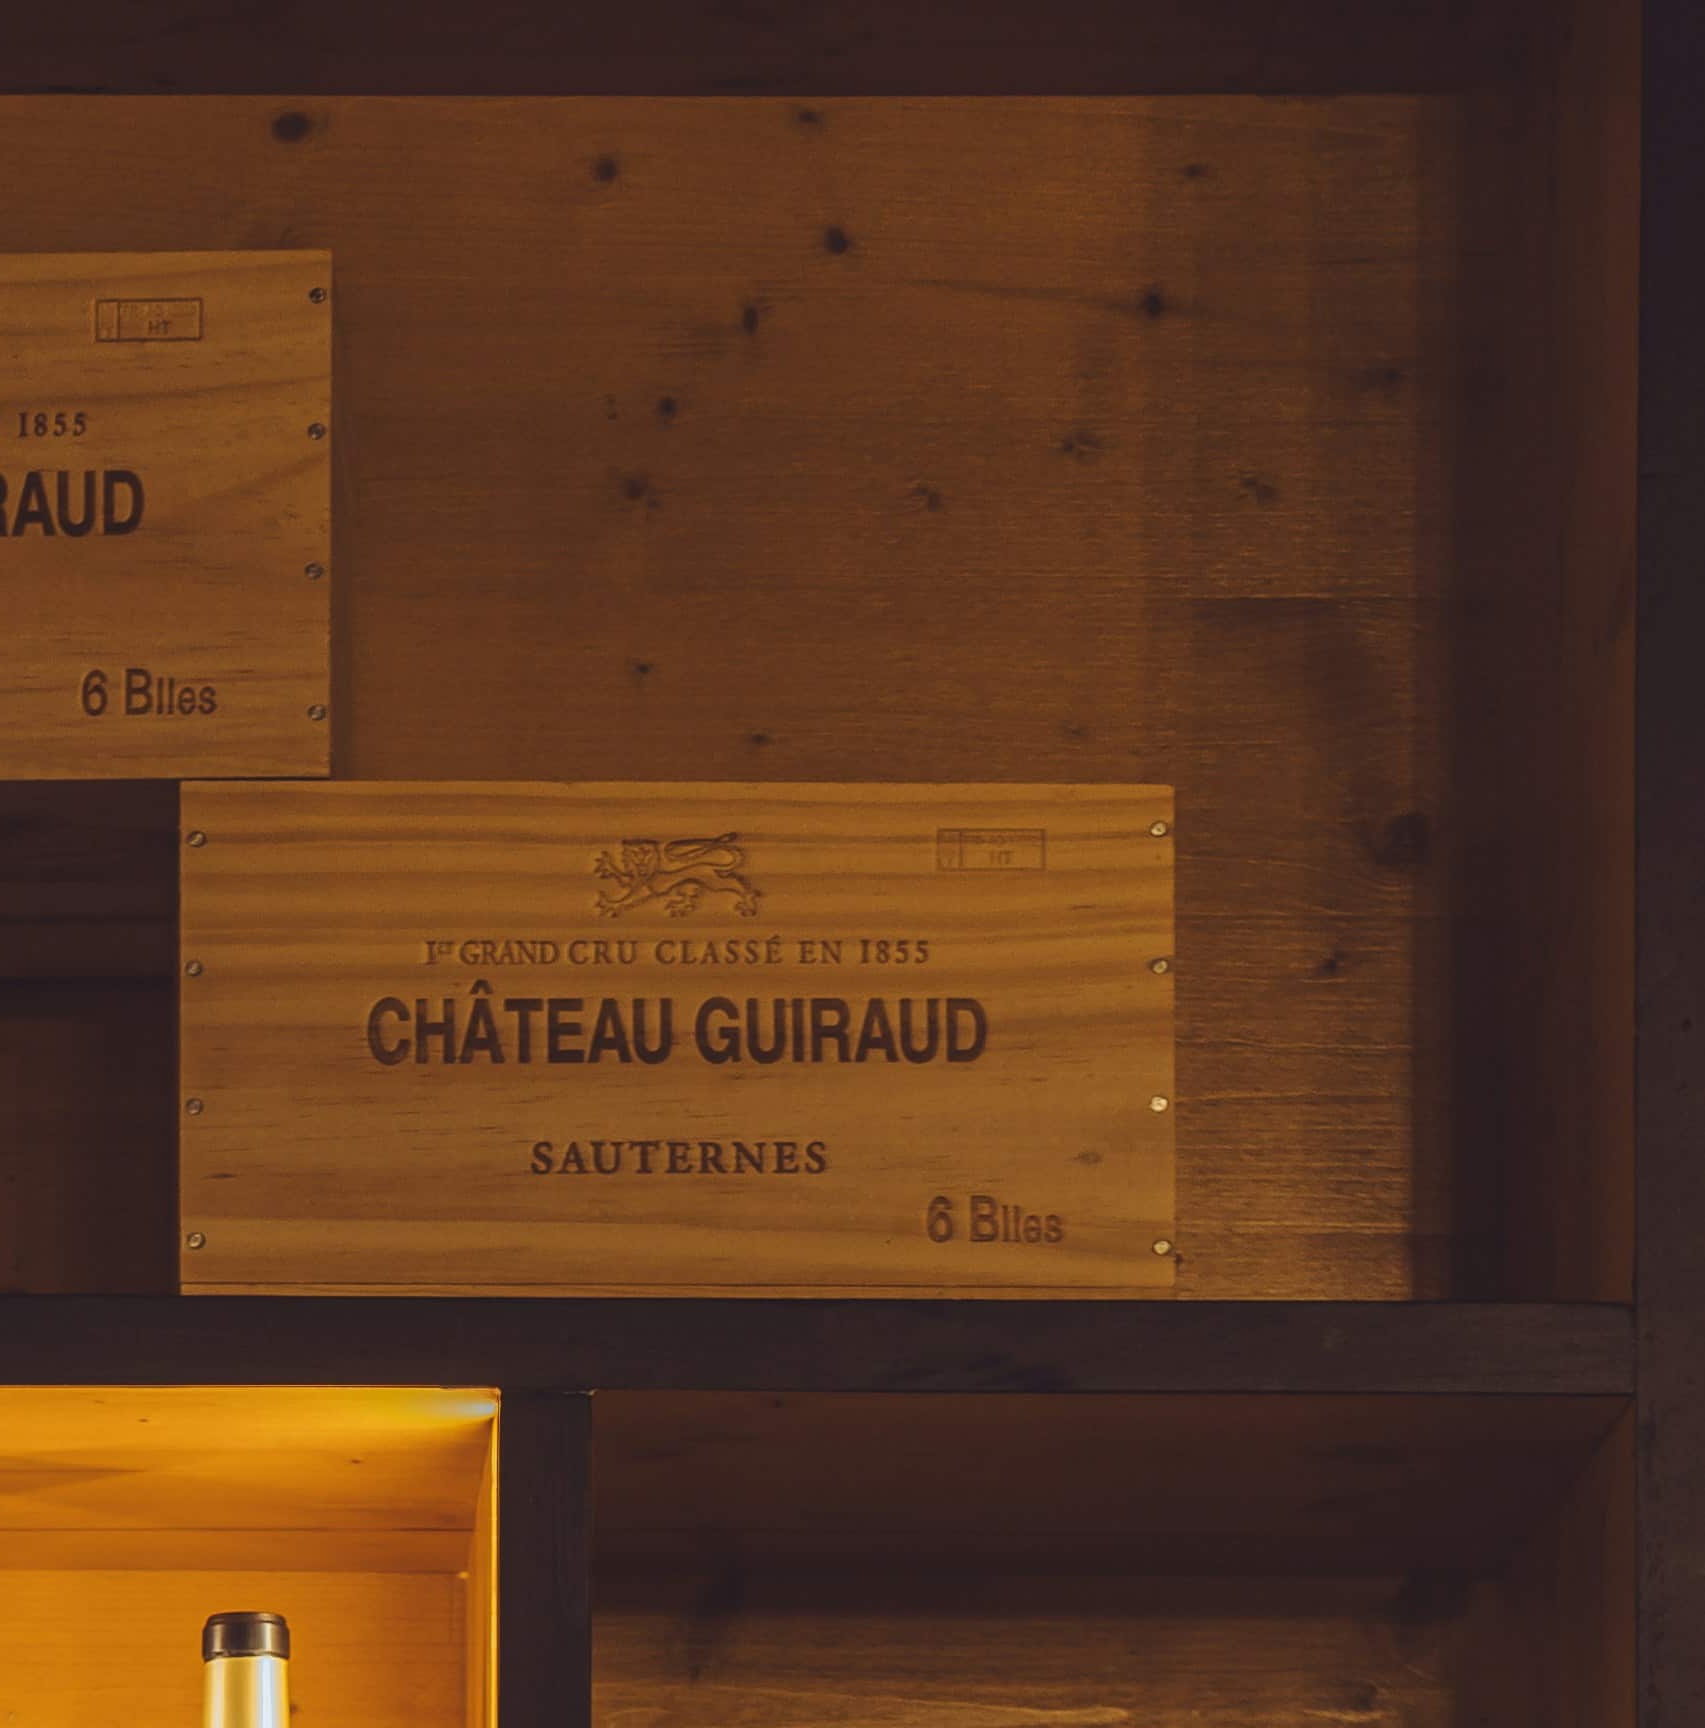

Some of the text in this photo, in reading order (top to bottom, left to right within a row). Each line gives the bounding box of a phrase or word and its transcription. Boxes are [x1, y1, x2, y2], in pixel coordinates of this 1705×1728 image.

[17, 412, 89, 438] 1855
[82, 669, 108, 716] 6
[459, 940, 559, 966] GRAND
[568, 939, 639, 965] CRU
[655, 934, 783, 965] CLASSÉ
[798, 940, 843, 965] EN
[859, 939, 929, 964] 1855
[368, 979, 988, 1065] CHÂTEAU GUIRAUD
[531, 1139, 828, 1176] SAUTERNES
[927, 1195, 954, 1243] 6
